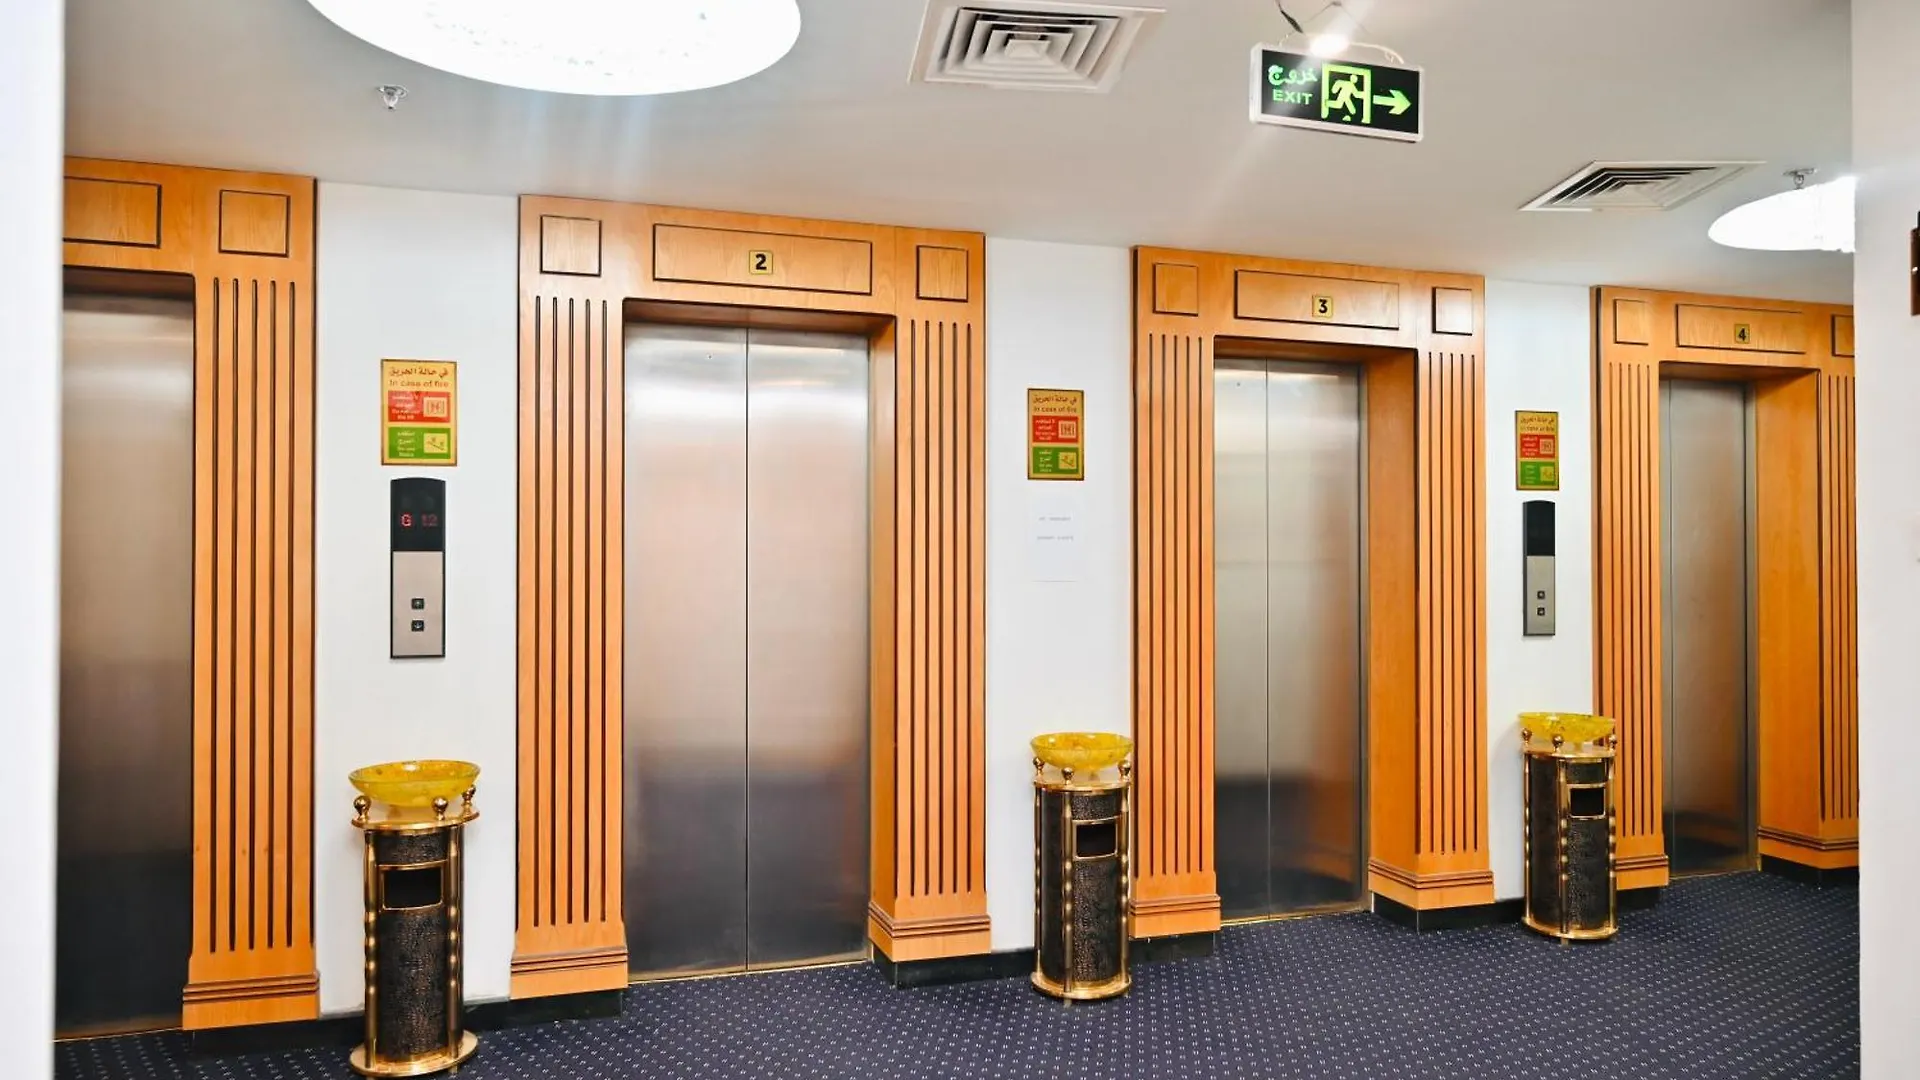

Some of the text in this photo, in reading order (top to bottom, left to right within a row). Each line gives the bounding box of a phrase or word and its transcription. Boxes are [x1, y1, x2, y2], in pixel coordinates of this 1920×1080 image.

[1267, 64, 1318, 86] خروج
[1273, 89, 1313, 105] EXIT
[755, 253, 767, 270] 2
[1318, 298, 1328, 313] 3
[1738, 327, 1747, 341] 4
[389, 366, 449, 378] في حالة الحريق
